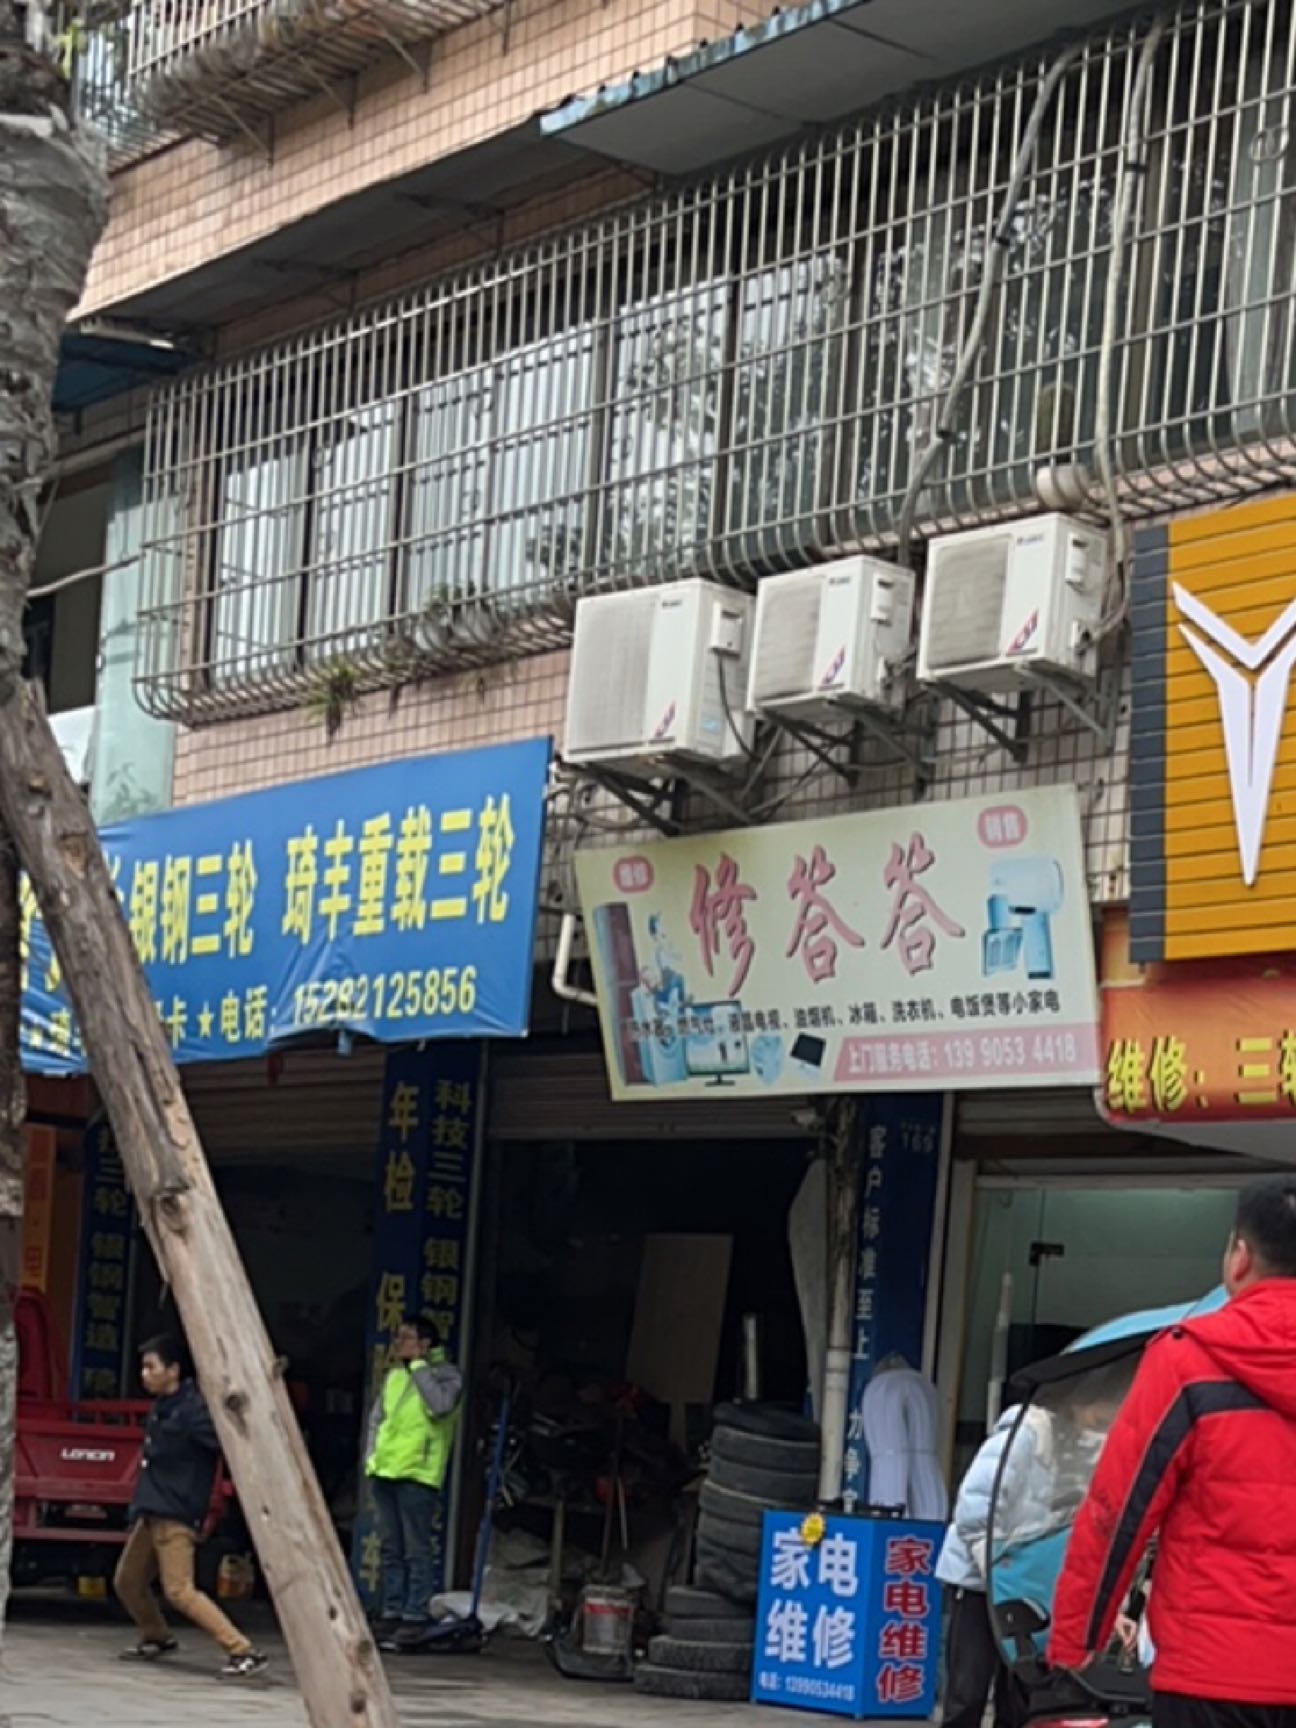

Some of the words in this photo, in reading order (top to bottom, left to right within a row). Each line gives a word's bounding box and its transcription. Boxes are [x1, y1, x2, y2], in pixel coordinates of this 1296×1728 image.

[106, 838, 258, 966] 银钢三轮
[769, 1527, 858, 1597] 家电
[764, 1597, 856, 1669] 维修
[876, 1535, 934, 1704] 家电维修
